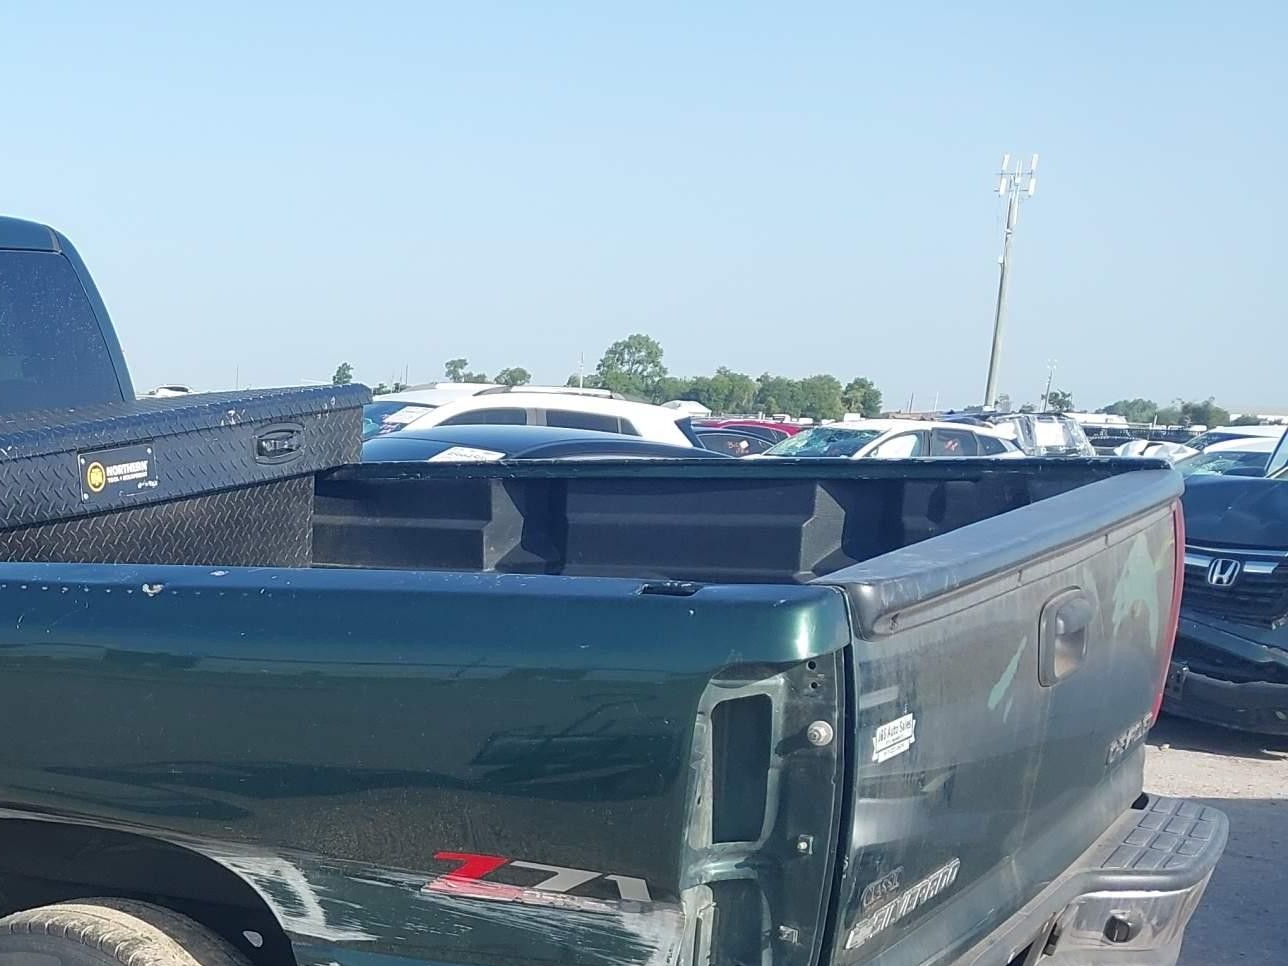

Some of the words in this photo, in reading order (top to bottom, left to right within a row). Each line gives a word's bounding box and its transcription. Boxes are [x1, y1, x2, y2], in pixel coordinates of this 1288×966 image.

[105, 460, 149, 477] NORTHERN
[420, 851, 654, 913] Z71
[870, 857, 961, 938] SILVERADO
